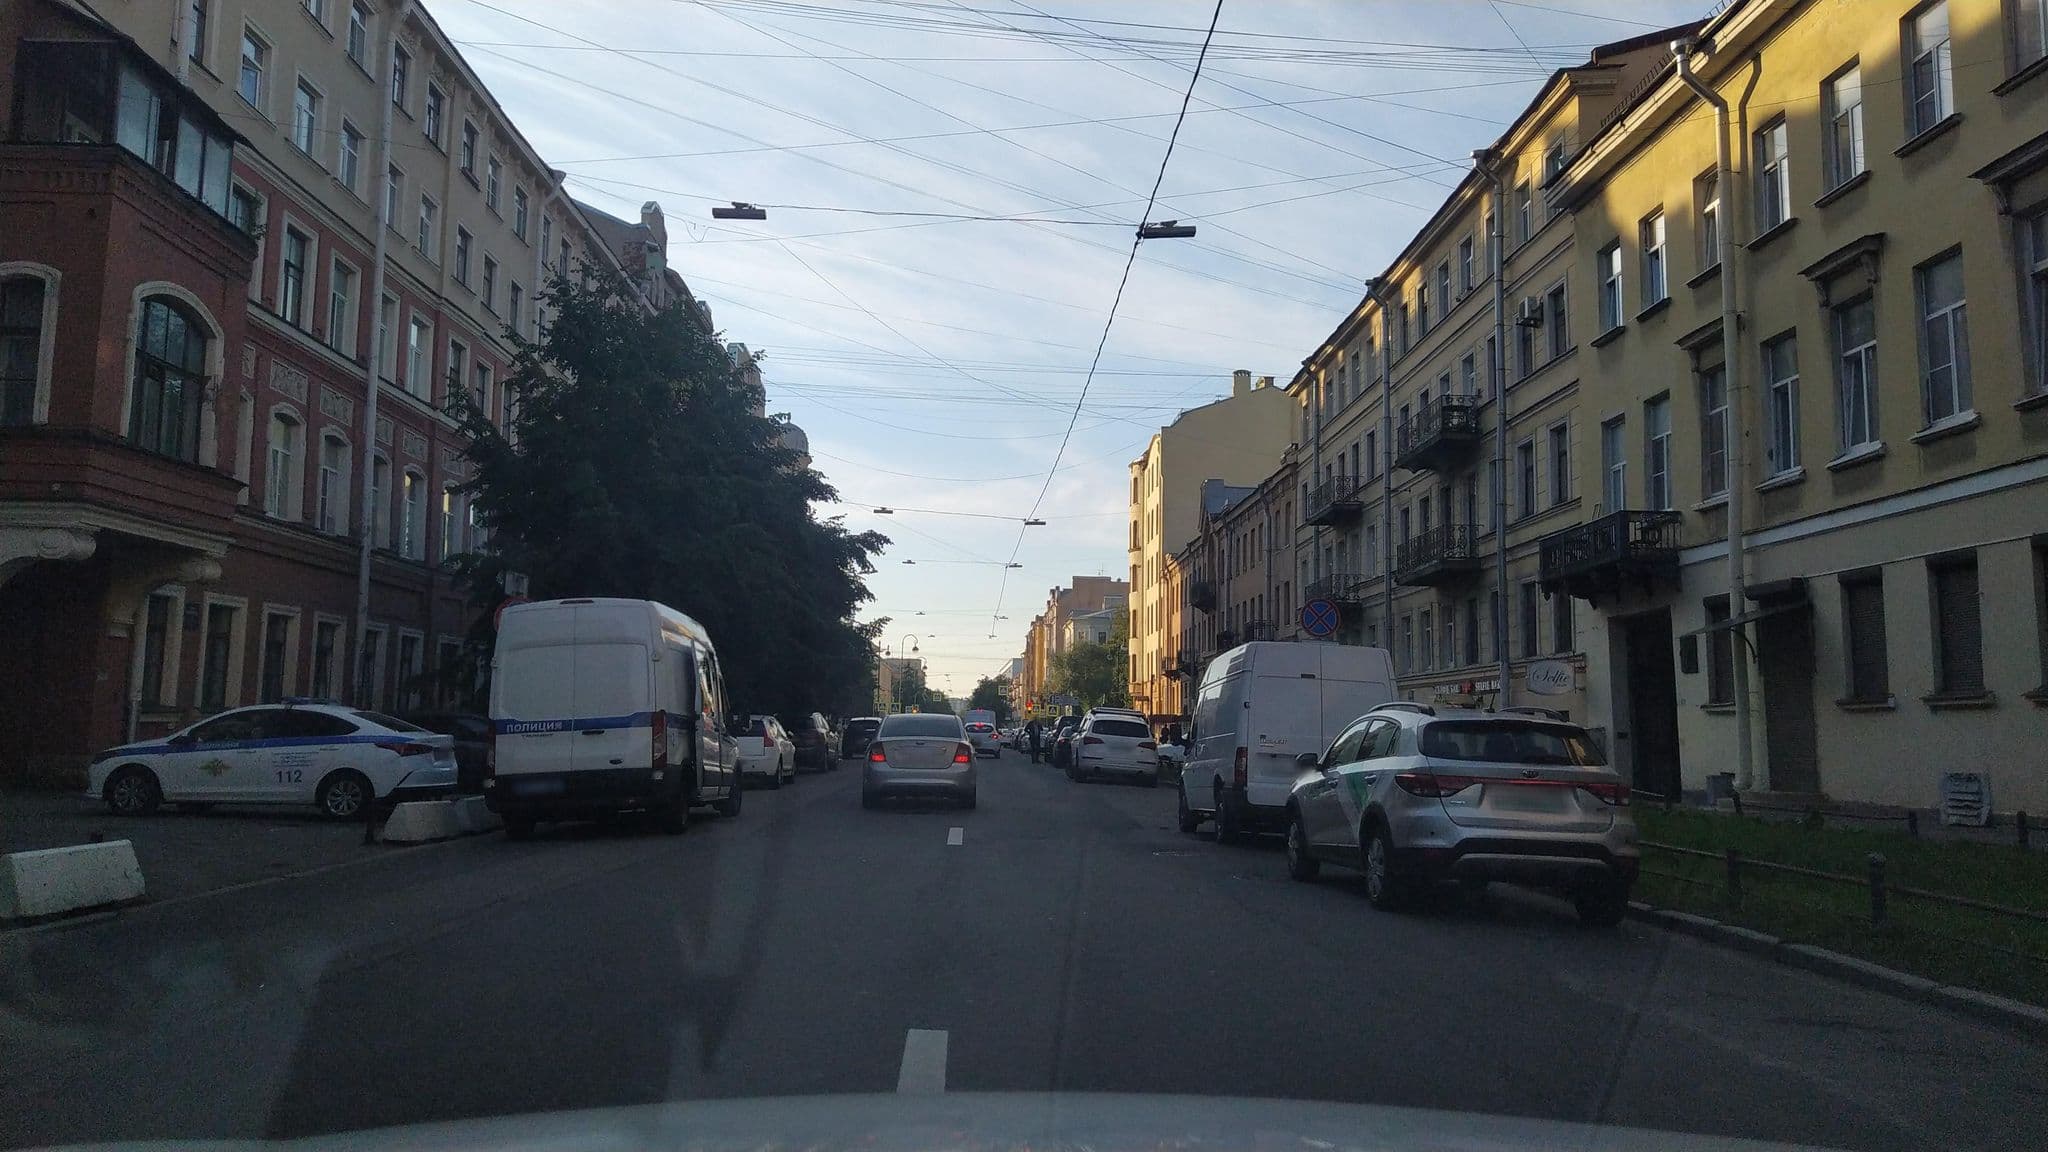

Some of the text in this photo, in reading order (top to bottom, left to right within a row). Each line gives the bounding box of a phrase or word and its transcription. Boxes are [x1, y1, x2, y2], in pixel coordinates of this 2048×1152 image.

[1532, 670, 1568, 684] Selfie
[506, 721, 563, 733] ПОЛИЦИЯ
[277, 770, 303, 783] 112
